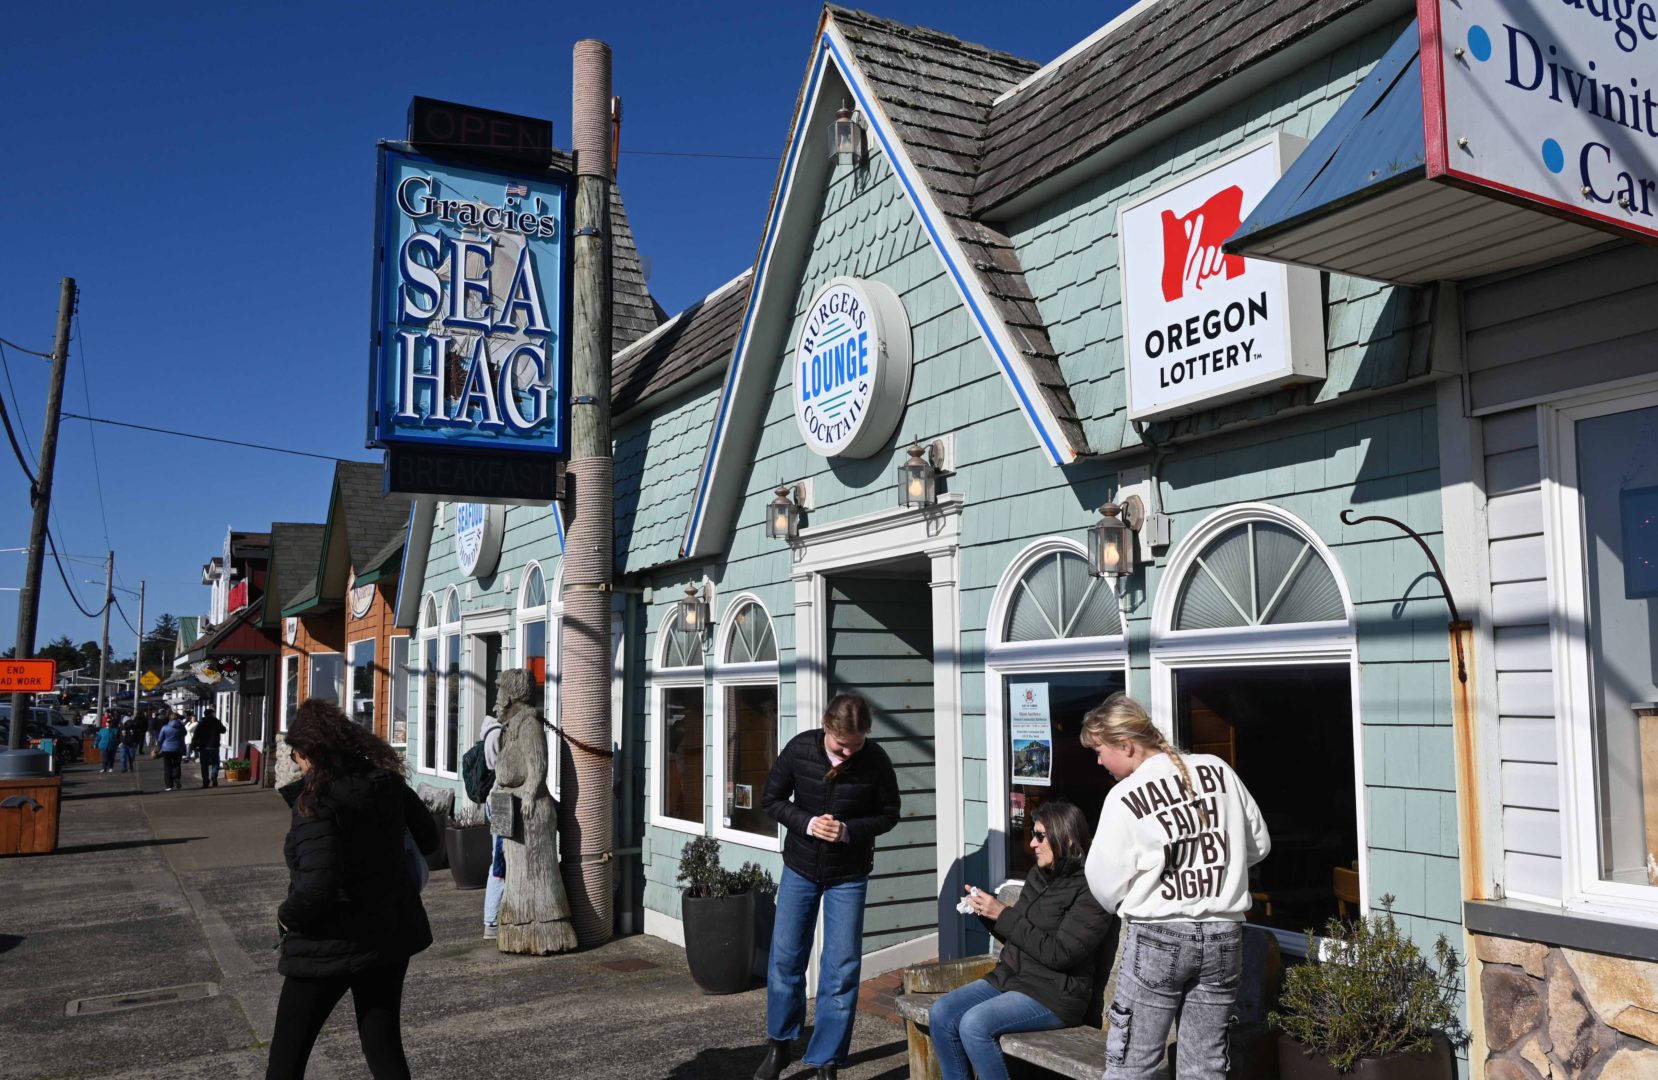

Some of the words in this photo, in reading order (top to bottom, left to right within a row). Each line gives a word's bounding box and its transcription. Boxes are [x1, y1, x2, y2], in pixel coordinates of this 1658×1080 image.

[424, 108, 542, 156] OPEN
[396, 175, 556, 238] Gracie's
[1580, 142, 1656, 217] Car
[399, 230, 551, 337] SEA
[803, 292, 866, 355] BURGERS
[1145, 291, 1268, 359] OREGON
[394, 331, 552, 434] HAG
[802, 330, 868, 402] LOUNGE
[1160, 338, 1255, 388] LOTTERY
[804, 381, 868, 443] COCKTAILS
[399, 453, 549, 494] BREAKFAST
[7, 666, 25, 674] END
[17, 677, 41, 685] WORK
[1195, 765, 1226, 793] BY
[1200, 830, 1227, 864] BY
[1160, 866, 1225, 900] SIGHT
